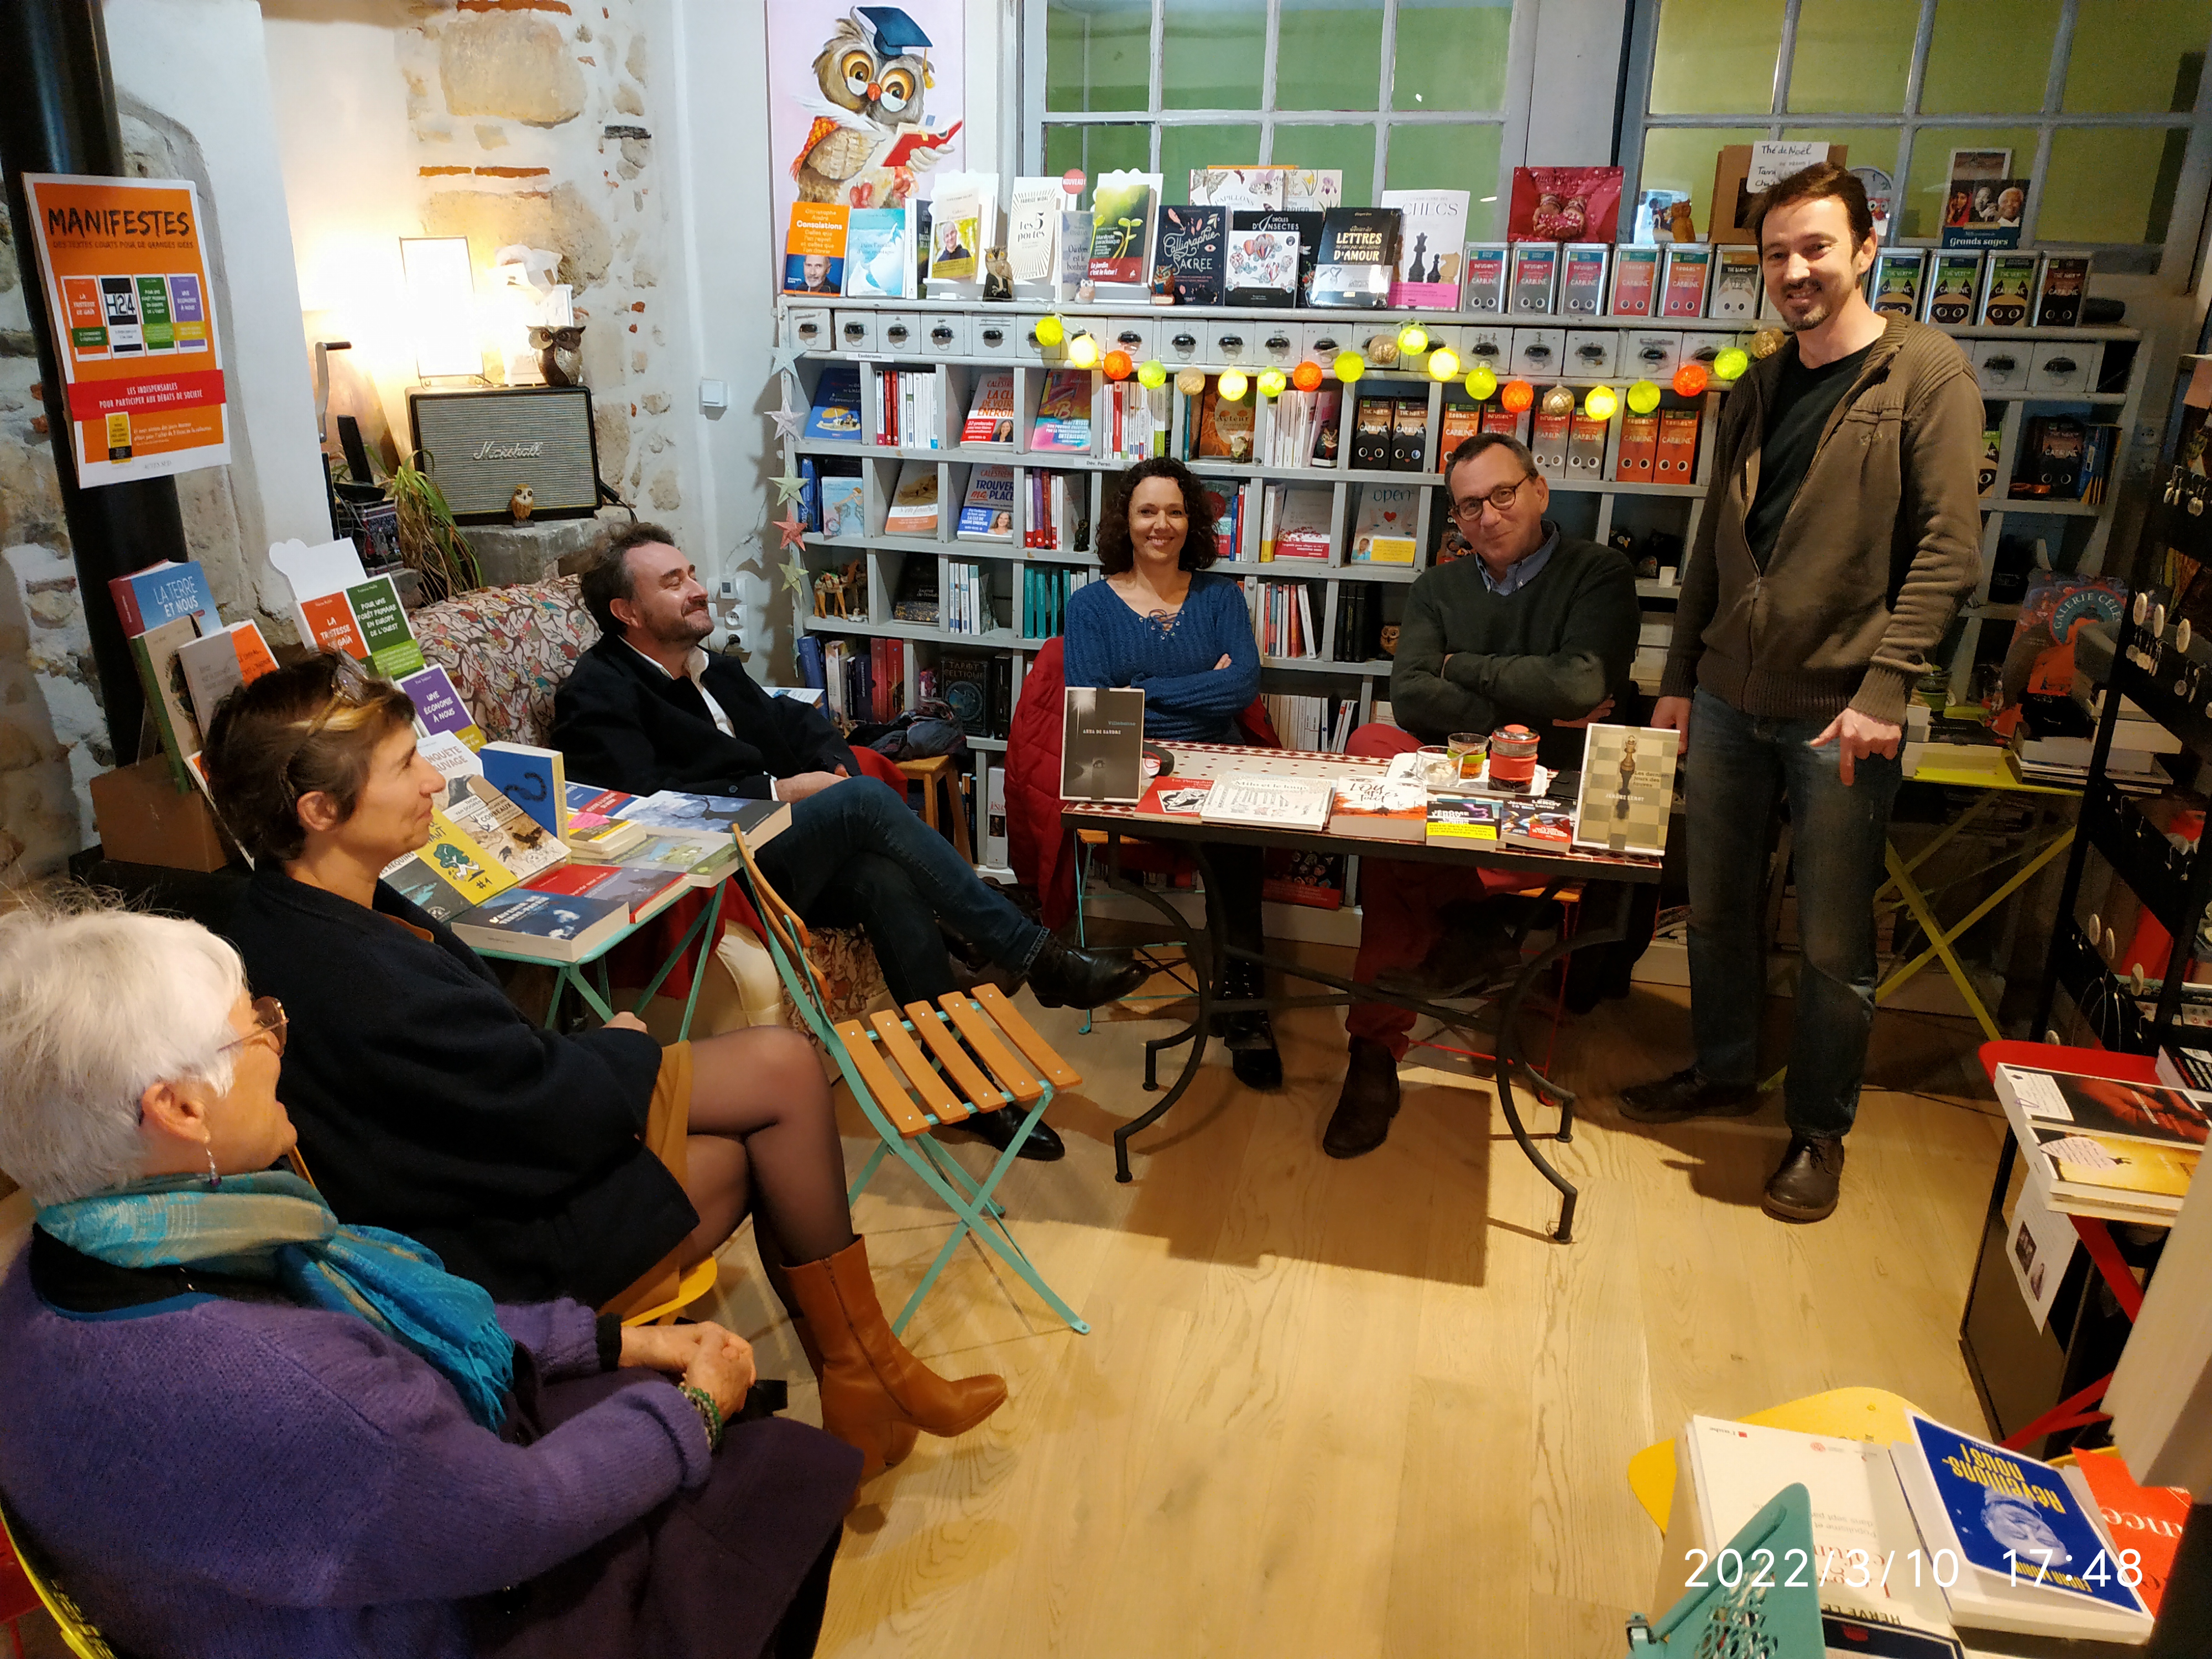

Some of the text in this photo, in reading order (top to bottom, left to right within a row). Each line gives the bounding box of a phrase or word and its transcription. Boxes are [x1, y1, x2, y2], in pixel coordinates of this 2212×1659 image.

[1762, 143, 1812, 155] Thé de Noël
[1401, 202, 1458, 216] CHECS
[48, 207, 190, 238] MANIFESTES
[796, 220, 843, 230] Consolations
[1034, 211, 1044, 230] 5
[1018, 231, 1045, 243] portes
[1163, 226, 1220, 257] Calligraphie
[1336, 232, 1383, 245] LETTRES
[1949, 237, 2009, 248] Grands sages
[1333, 250, 1380, 262] D'AMOUR
[105, 293, 137, 316] H24
[127, 382, 178, 395] LES INDISPENSABLES
[987, 390, 999, 399] LA
[99, 399, 114, 409] POUR
[115, 397, 145, 408] PARTICIPER
[146, 394, 156, 403] AUX
[176, 392, 183, 400] DE
[982, 399, 991, 407] DE
[1359, 424, 1387, 432] CAROLINE
[473, 441, 543, 461] Marshall
[971, 490, 1014, 502] ma PLACE
[1373, 489, 1411, 504] open
[153, 576, 199, 606] LA TERRE
[164, 595, 199, 618] ET NOUS
[360, 597, 387, 611] POUR UNE
[2053, 592, 2094, 629] GALERIE
[357, 604, 397, 622] FORÊT PRIMAIRE
[375, 614, 395, 625] EUROPE
[326, 617, 337, 627] LA
[369, 623, 399, 638] DE L'OUEST
[337, 635, 353, 647] GAÏA
[948, 661, 980, 671] TAROT
[426, 691, 440, 701] UNE
[432, 707, 456, 723] À NOUS
[434, 755, 468, 772] AUVAGE
[1234, 780, 1258, 789] Milo
[1283, 784, 1309, 792] loup
[480, 802, 513, 822] CORBEAUX
[388, 852, 415, 870] REQUINS
[476, 877, 493, 889] #1
[1942, 1455, 2067, 1515] Réveillons-
[1825, 1514, 1874, 1528] dans sept
[1813, 1521, 1877, 1539] Populisme et
